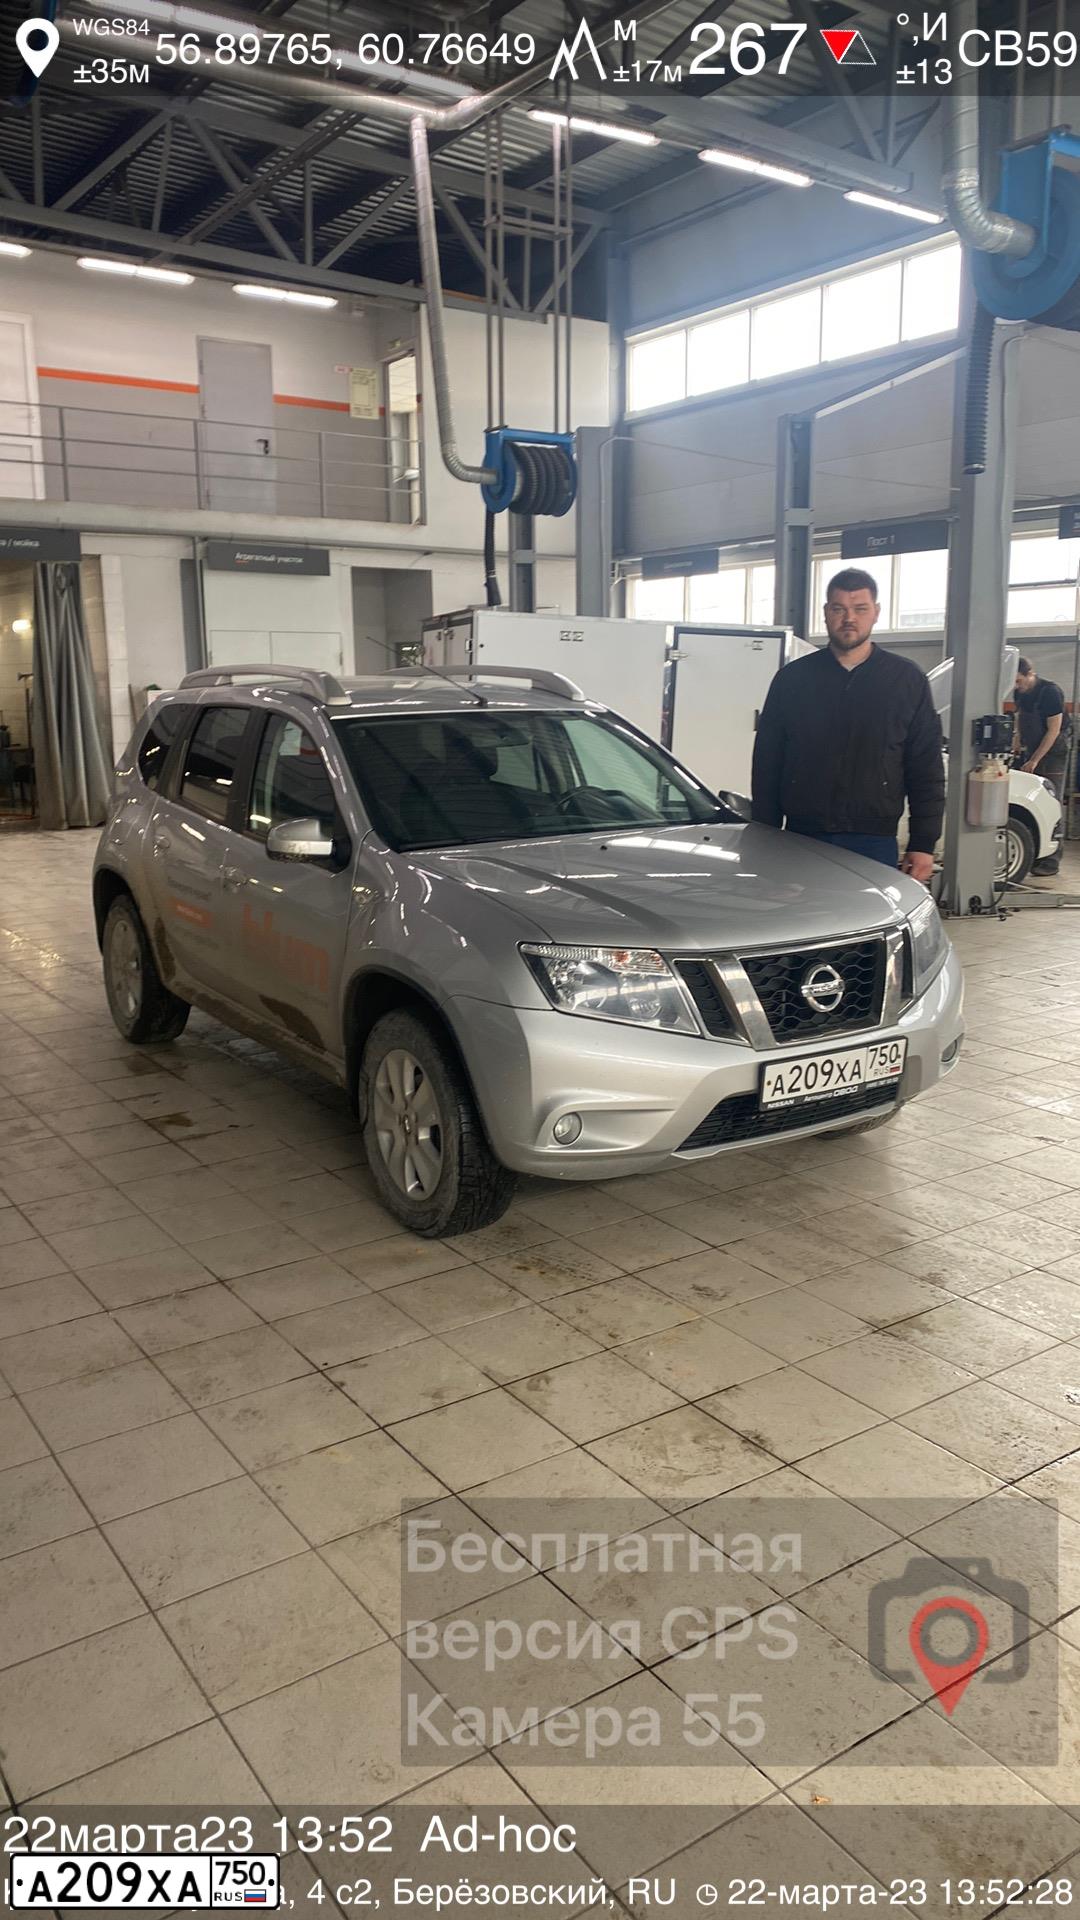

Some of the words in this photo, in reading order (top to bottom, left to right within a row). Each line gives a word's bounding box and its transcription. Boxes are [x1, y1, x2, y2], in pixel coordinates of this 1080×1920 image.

[771, 1059, 862, 1097] А209ХА
[869, 1043, 899, 1069] 750
[873, 1065, 890, 1077] RUS
[767, 1099, 795, 1109] NISSAN
